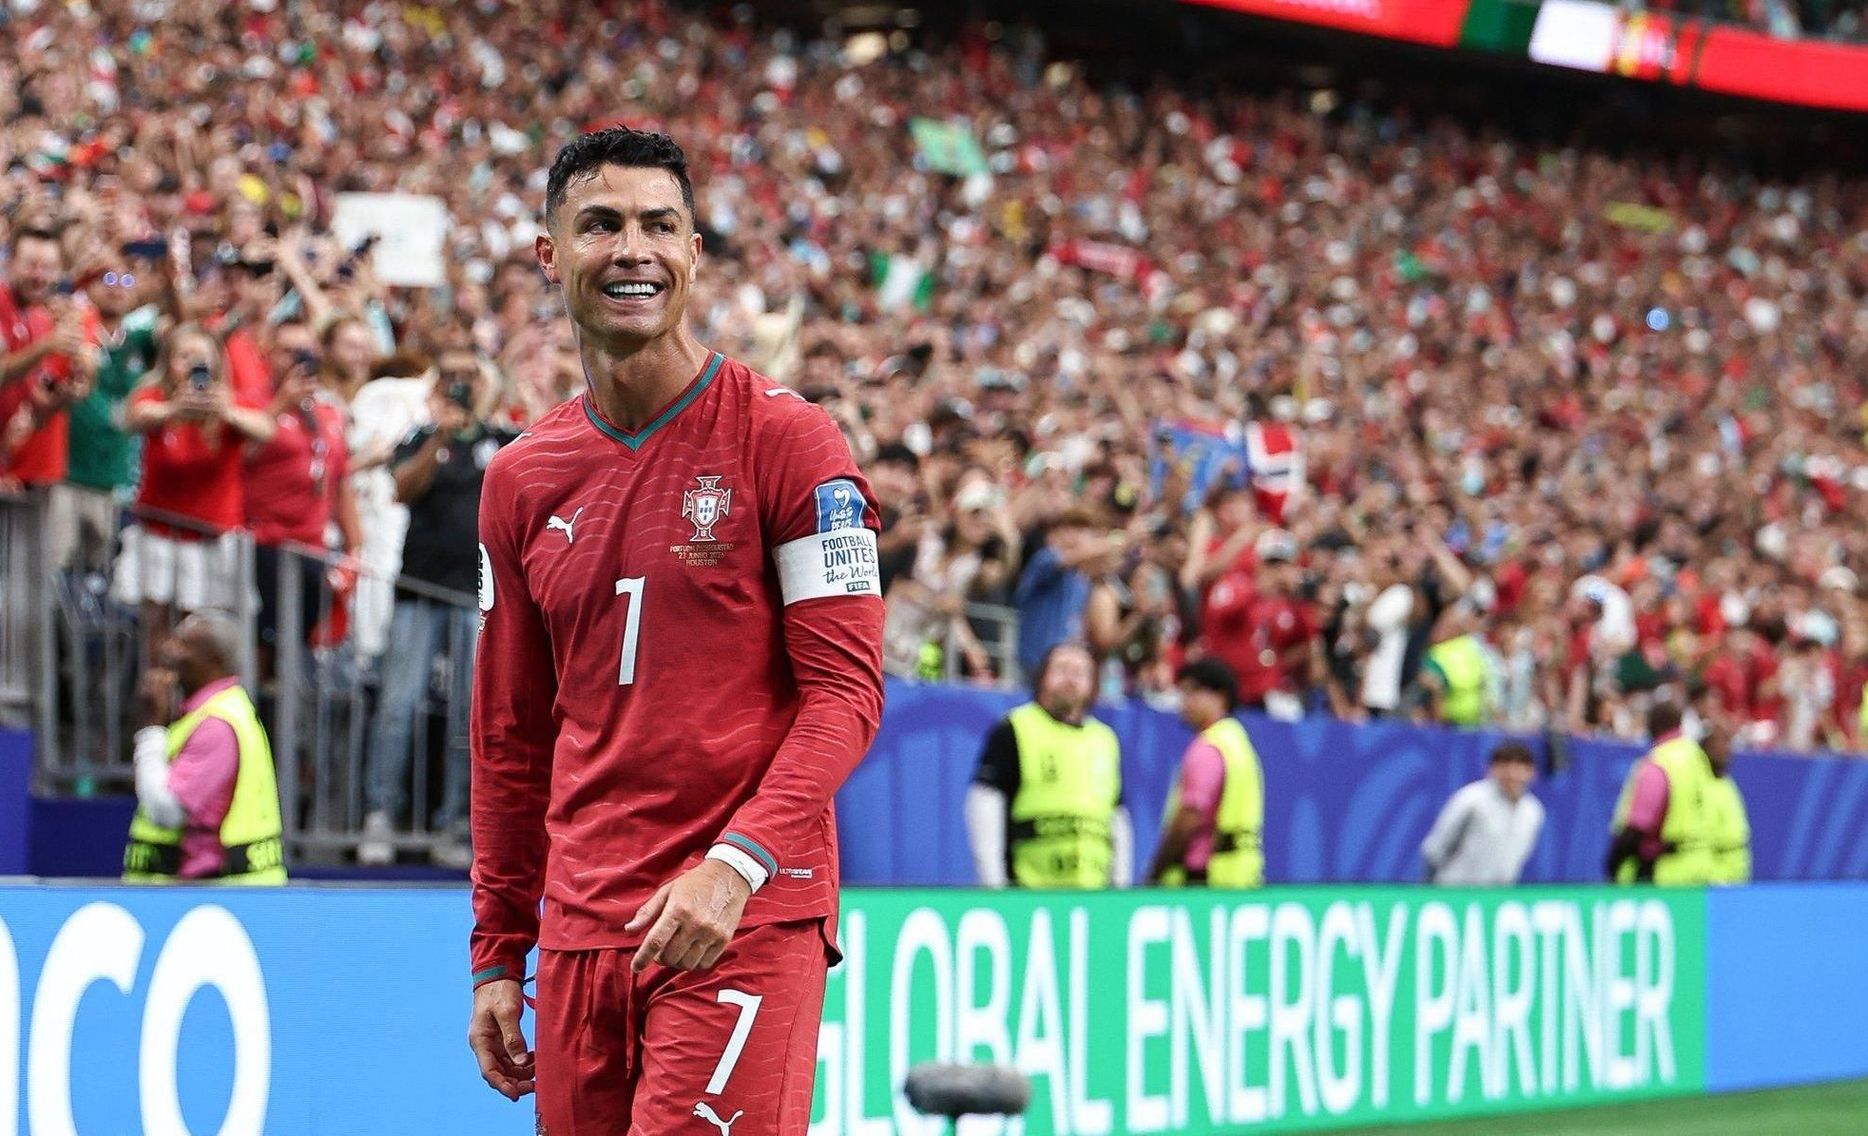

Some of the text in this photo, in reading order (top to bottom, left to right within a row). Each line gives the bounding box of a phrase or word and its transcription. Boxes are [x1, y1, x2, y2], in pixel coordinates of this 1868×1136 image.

[822, 536, 873, 552] FOOTBALL
[686, 559, 718, 567] HOUSTON
[824, 548, 876, 568] UNITES
[822, 569, 848, 584] the
[847, 581, 870, 592] FIFA
[615, 576, 646, 686] 7
[0, 900, 272, 1136] co
[1126, 899, 1409, 1134] ENERGY
[1413, 898, 1677, 1108] PARTNER
[705, 989, 763, 1096] 7
